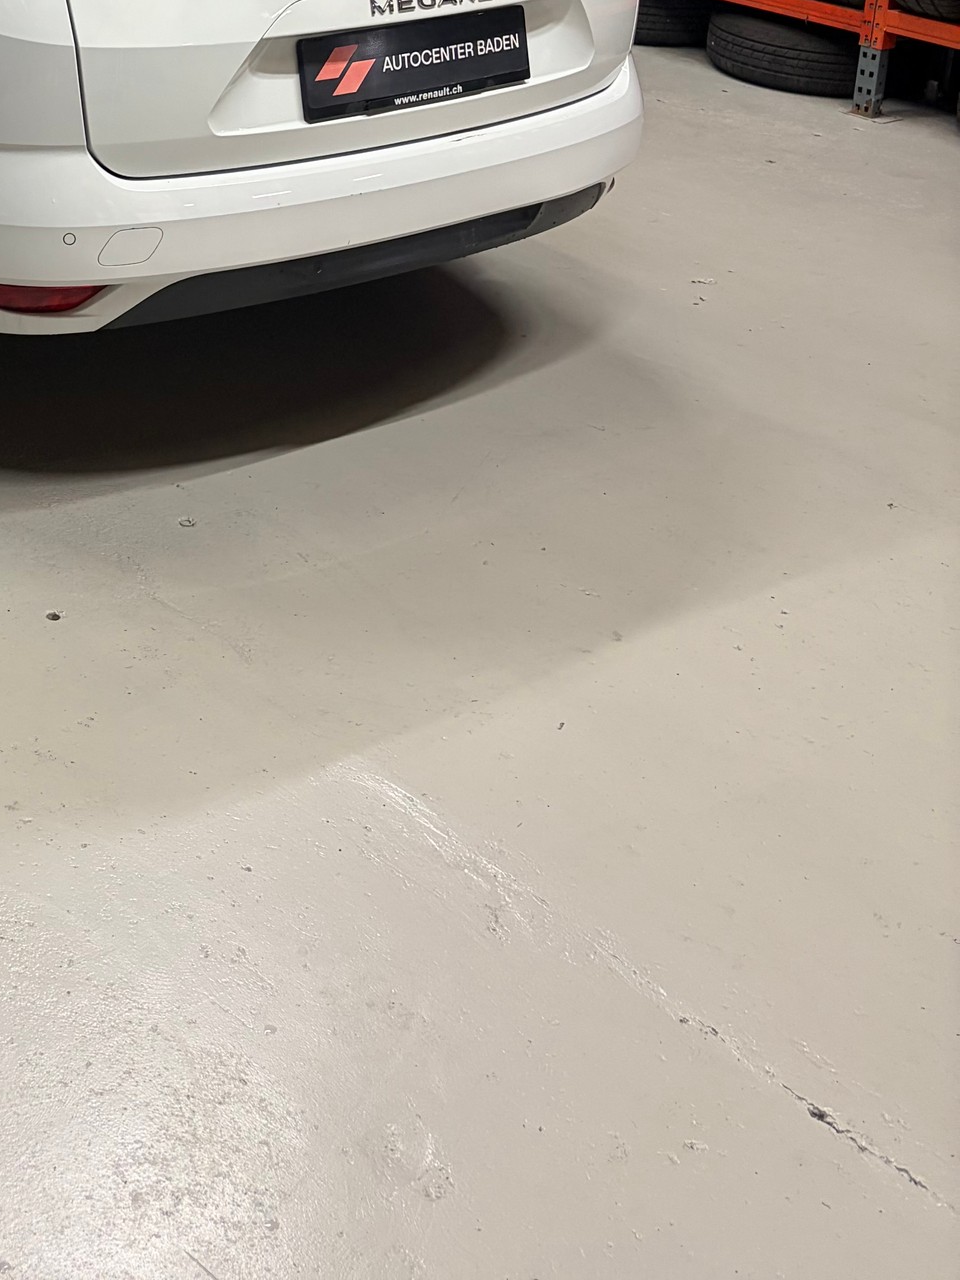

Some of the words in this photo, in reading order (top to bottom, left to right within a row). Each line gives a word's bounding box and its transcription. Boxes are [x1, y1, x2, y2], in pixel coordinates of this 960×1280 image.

[382, 41, 474, 73] AUTOCENTER
[477, 33, 520, 56] BADEN
[394, 84, 463, 106] www.renault.ch
